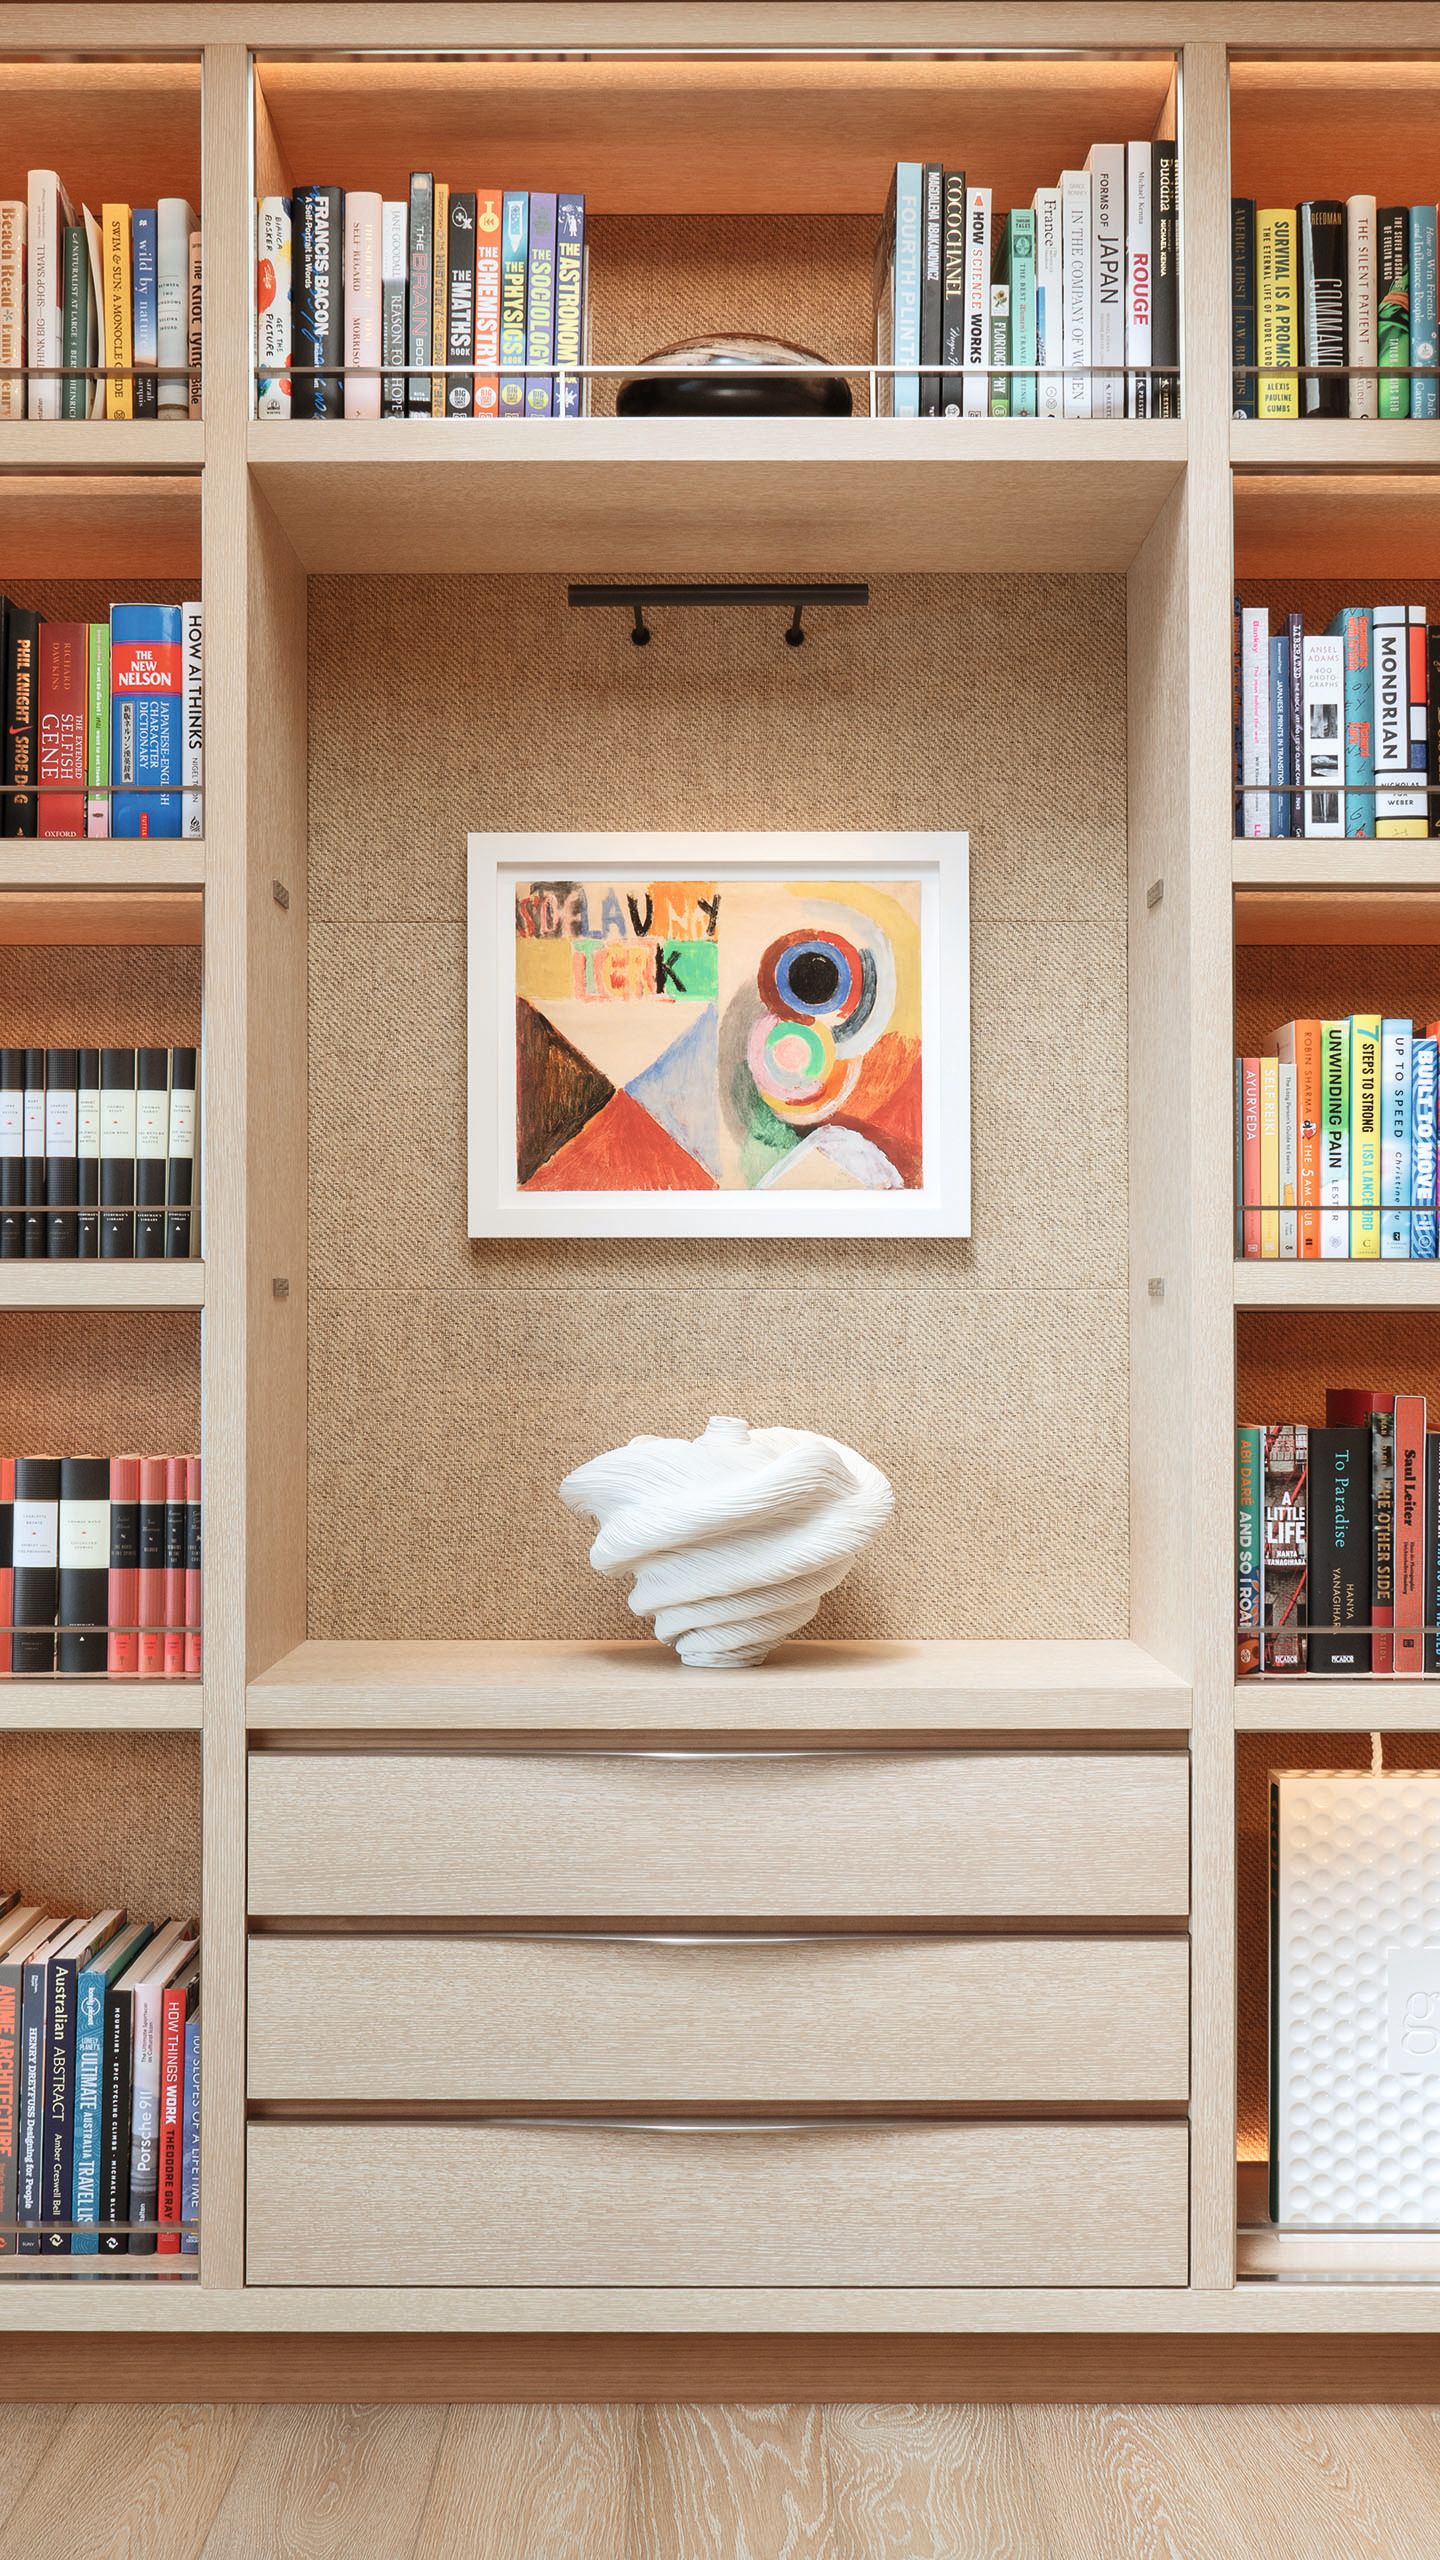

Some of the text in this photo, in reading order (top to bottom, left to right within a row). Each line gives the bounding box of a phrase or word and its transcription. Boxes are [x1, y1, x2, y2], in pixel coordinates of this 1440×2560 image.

[1099, 173, 1109, 210] FORMS
[416, 225, 425, 251] THE
[928, 171, 940, 281] MAGDALENA ABAKANOWICZ
[945, 176, 963, 300] COCO CHANEL
[1044, 200, 1057, 247] France
[1099, 213, 1109, 227] OF
[1234, 208, 1247, 261] AMERICA
[1358, 218, 1369, 239] THE
[1, 207, 16, 307] Beach Read
[37, 244, 46, 277] SMALL
[315, 196, 329, 336] FRANCIS BACON
[451, 269, 471, 281] THE
[478, 246, 498, 257] THE
[505, 261, 525, 272] THE
[531, 248, 551, 260] THE
[559, 243, 580, 256] THE
[1097, 235, 1119, 304] JAPAN
[1274, 221, 1290, 312] SURVIVAL IS A
[1358, 247, 1370, 287] SILENT
[1413, 241, 1425, 289] Influence
[70, 245, 79, 338] NATURALIST LARGE
[134, 239, 153, 347] wild by nature
[304, 263, 313, 289] Words
[970, 211, 985, 364] HOW SCIENCE WORKS
[1071, 210, 1085, 346] IN THE COMPANY OF
[1132, 253, 1149, 326] ROUGE
[1263, 227, 1273, 342] THE ETERNAL LIFE OF AUDRE
[1427, 283, 1437, 321] Friends
[113, 304, 123, 357] MONOCLE
[265, 313, 274, 357] PICTURE
[450, 282, 472, 347] MATHS
[502, 273, 525, 355] PHYSICS
[1358, 294, 1371, 344] PATIENT
[37, 337, 46, 368] THINK
[391, 295, 403, 411] REASON HOPE
[1266, 383, 1291, 391] ALEXIS
[135, 650, 154, 660] THE
[1251, 619, 1261, 654] Banksy
[1308, 654, 1340, 663] ADAMS
[1309, 646, 1337, 654] ANSEL
[15, 639, 31, 724] PHIL KNIGHT
[52, 642, 61, 690] DAWKINS
[63, 642, 72, 690] RICHARD
[118, 672, 172, 686] NELSON
[131, 661, 158, 672] NEW
[188, 615, 203, 749] HOW AI THINKS
[1314, 667, 1333, 675] 400
[75, 714, 83, 730] THE
[1276, 679, 1284, 714] JAPANESE
[1381, 636, 1398, 760] MONDRIAN
[15, 735, 30, 771] SHOE
[41, 713, 60, 779] GENE
[61, 713, 74, 779] SELFISH
[139, 701, 149, 769] DICTIONARY
[149, 701, 159, 768] CHARACTER
[44, 830, 77, 838] OXFORD
[1284, 1088, 1292, 1101] Lazy
[1303, 1032, 1313, 1114] ROBIN SHARMA
[1329, 1029, 1342, 1167] UNWINDING PAIN
[1356, 1024, 1380, 1133] 7 STEPS TO STRONG
[1394, 1037, 1405, 1138] UP TO SPEED
[1417, 1049, 1434, 1105] BUILT
[1246, 1070, 1257, 1141] AYURVEDA
[1263, 1068, 1276, 1136] SELF REIKI
[1417, 1111, 1434, 1138] TO
[1301, 1144, 1314, 1196] THE 5 AM
[1361, 1143, 1375, 1167] LISA
[1393, 1151, 1403, 1203] Christine
[1416, 1142, 1434, 1200] MOVE
[1403, 1449, 1417, 1482] Saul
[1239, 1439, 1253, 1574] ABI AND SO
[1266, 1506, 1306, 1521] LITTLE
[1281, 1490, 1292, 1506] A
[1335, 1449, 1350, 1549] To Paradise
[1403, 1484, 1417, 1527] Leiter
[1266, 1521, 1306, 1544] LIFE
[1376, 1514, 1391, 1600] OTHER SIDE
[1346, 1583, 1354, 1620] HANYA
[1331, 1655, 1354, 1663] PICADOR
[52, 1965, 69, 2122] Australian ABSTRACT
[165, 2001, 180, 2124] HOW THINGS WORK
[0, 2039, 14, 2157] ARCHITECTURE
[23, 2027, 38, 2209] HENRY DREYFUSS Designing for People
[77, 2052, 98, 2204] ULTIMATE AUSTRALIA TRAVEL
[136, 2090, 153, 2172] Porsche 911
[52, 2132, 62, 2215] Amber Creswell Bell
[164, 2128, 176, 2219] THEODORE GRAY
